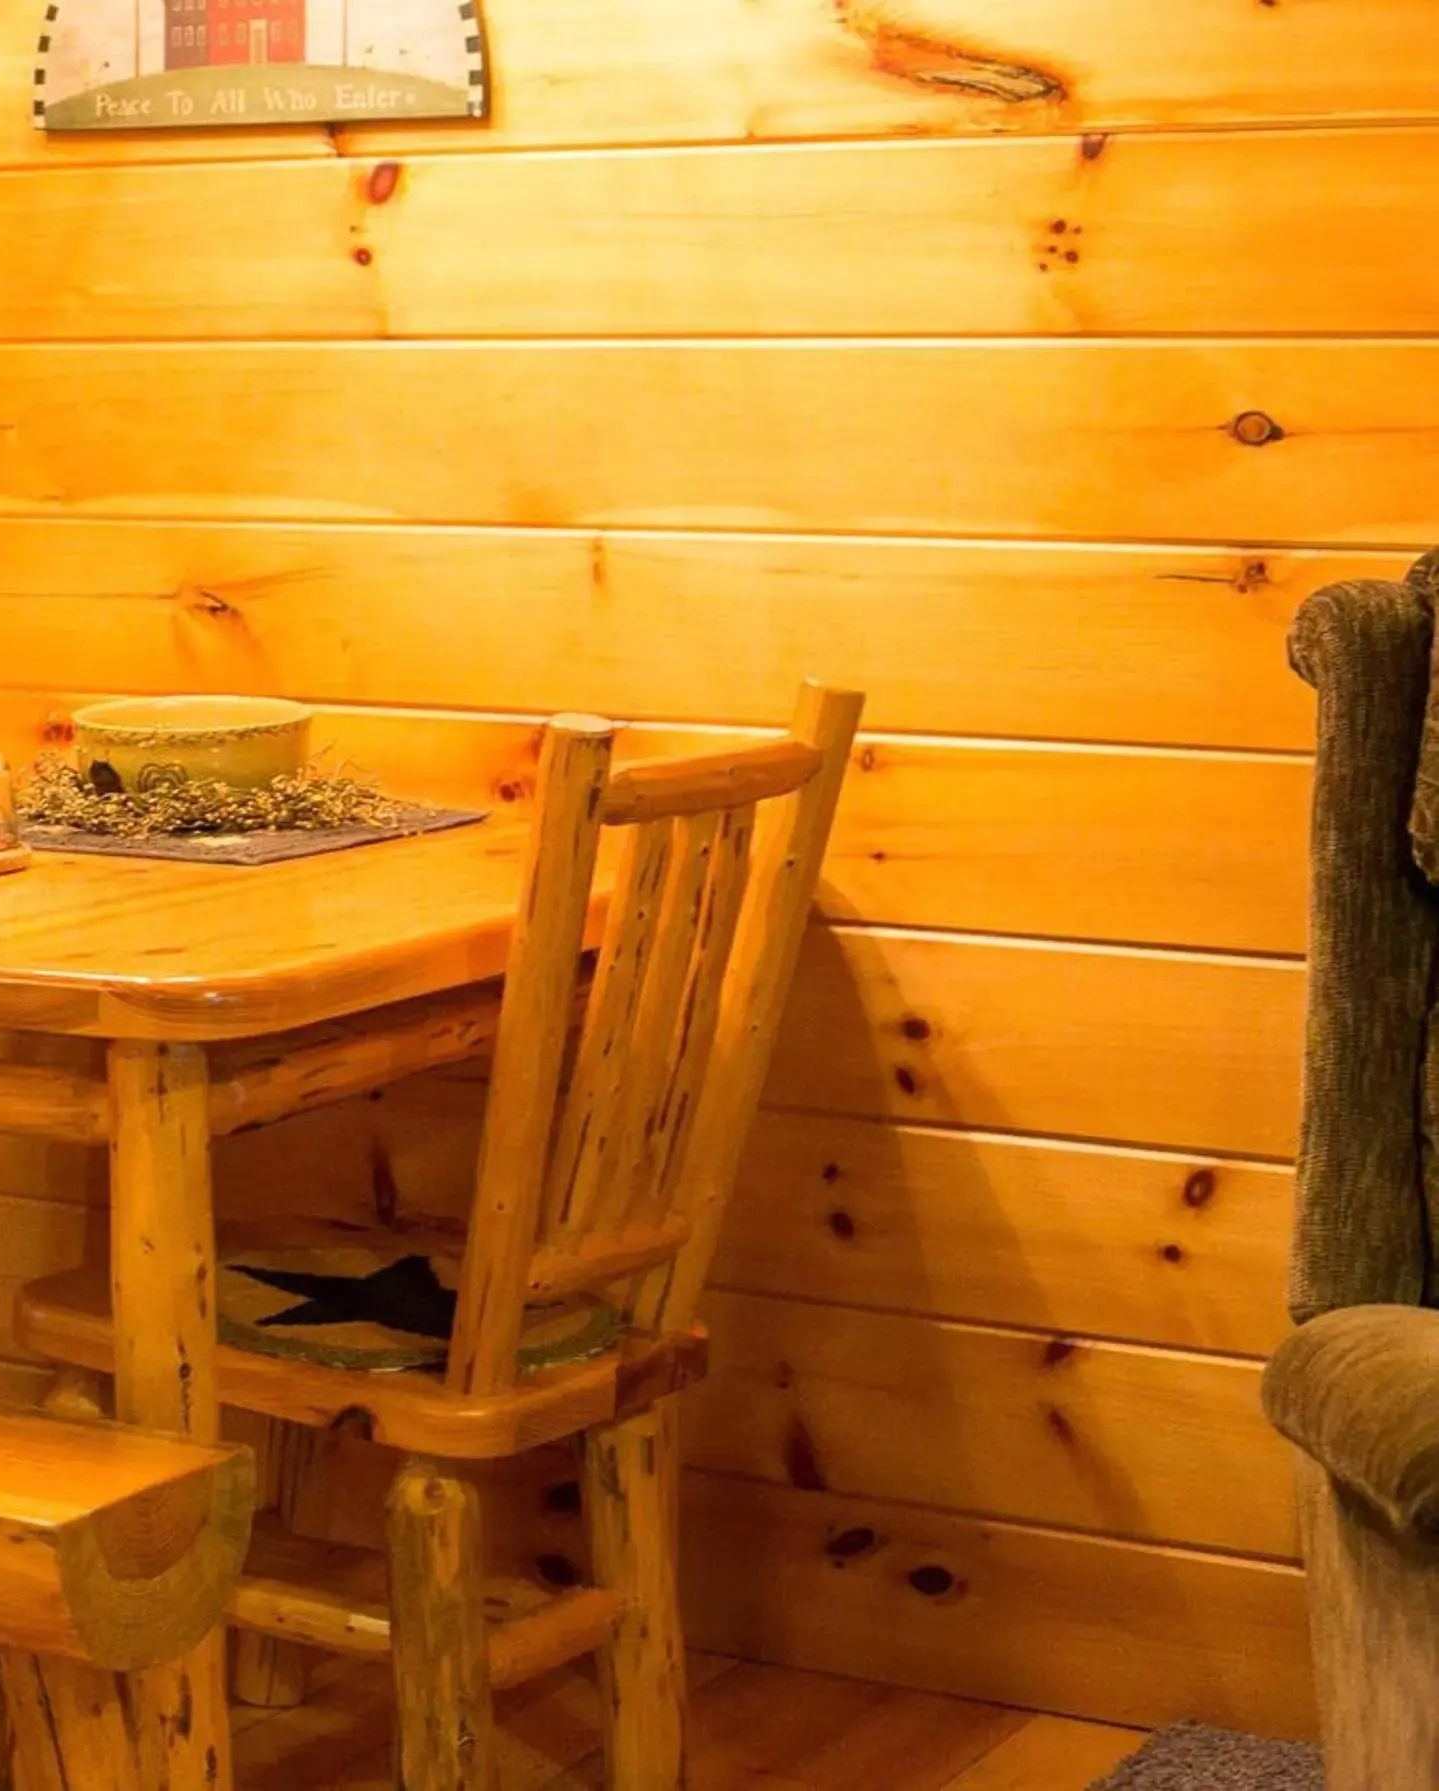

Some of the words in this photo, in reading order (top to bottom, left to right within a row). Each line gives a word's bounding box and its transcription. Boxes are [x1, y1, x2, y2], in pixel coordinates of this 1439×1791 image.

[95, 93, 152, 117] Peace
[165, 90, 194, 116] To
[210, 88, 247, 114] All
[262, 86, 317, 111] Who
[334, 84, 402, 109] Enter
